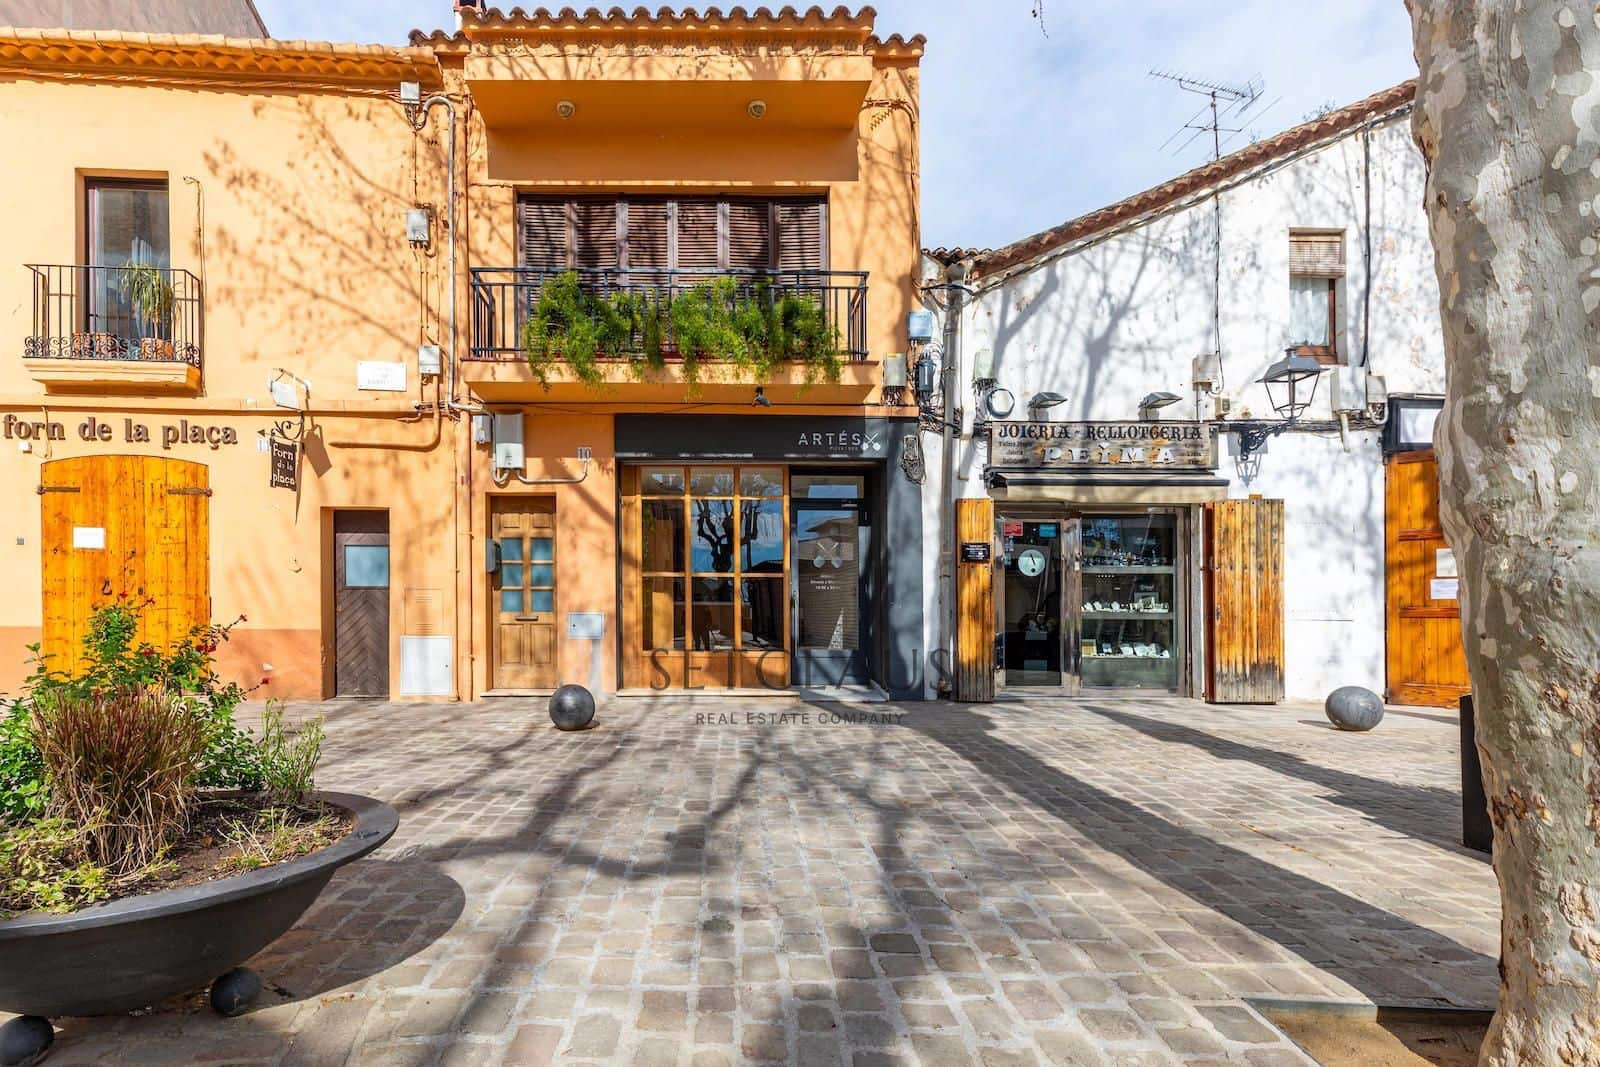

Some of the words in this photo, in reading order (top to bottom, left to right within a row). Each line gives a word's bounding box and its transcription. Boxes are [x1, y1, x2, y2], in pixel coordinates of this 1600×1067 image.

[2, 414, 65, 441] forn
[78, 416, 113, 442] de
[124, 418, 150, 443] la
[162, 420, 238, 449] plaça
[798, 430, 861, 446] ARTÉS
[998, 424, 1071, 440] JOIERIA
[1087, 425, 1202, 441] RELLOTGERIA
[272, 467, 295, 487] plaça
